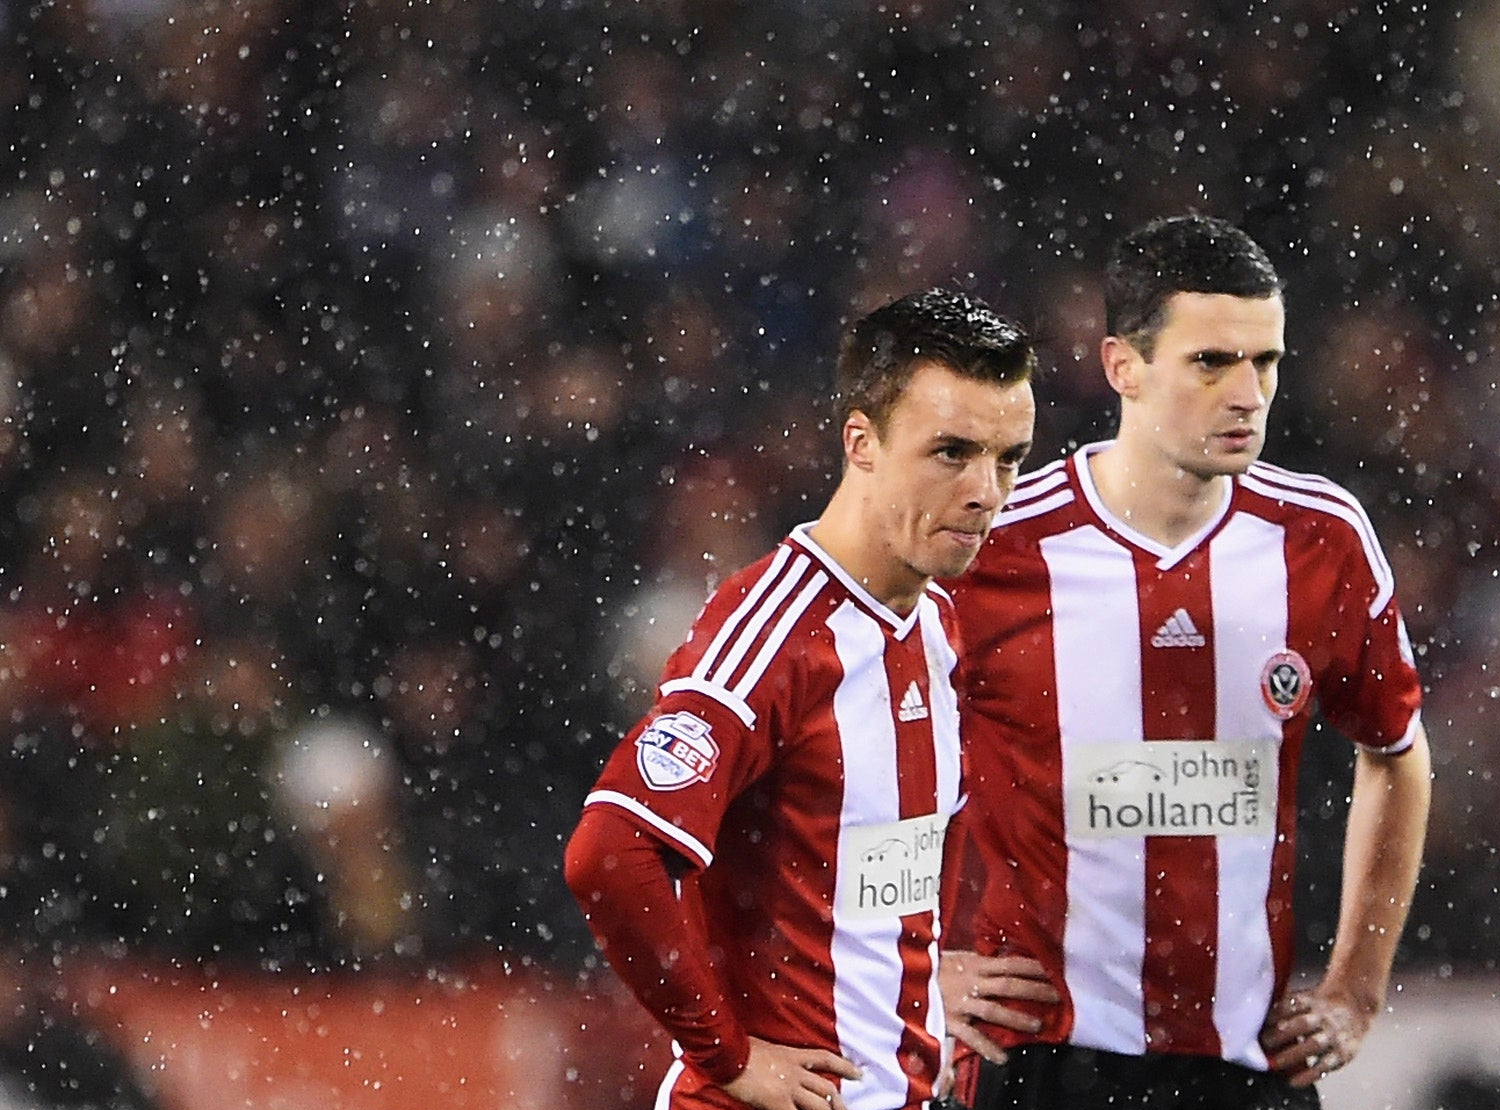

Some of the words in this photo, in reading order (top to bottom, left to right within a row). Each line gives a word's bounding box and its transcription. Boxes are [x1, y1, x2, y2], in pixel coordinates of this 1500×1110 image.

[672, 741, 712, 773] BET
[1172, 750, 1238, 786] john
[1088, 792, 1237, 829] holland
[1244, 758, 1259, 826] sales
[914, 822, 947, 861] joh
[859, 868, 941, 909] hollan
